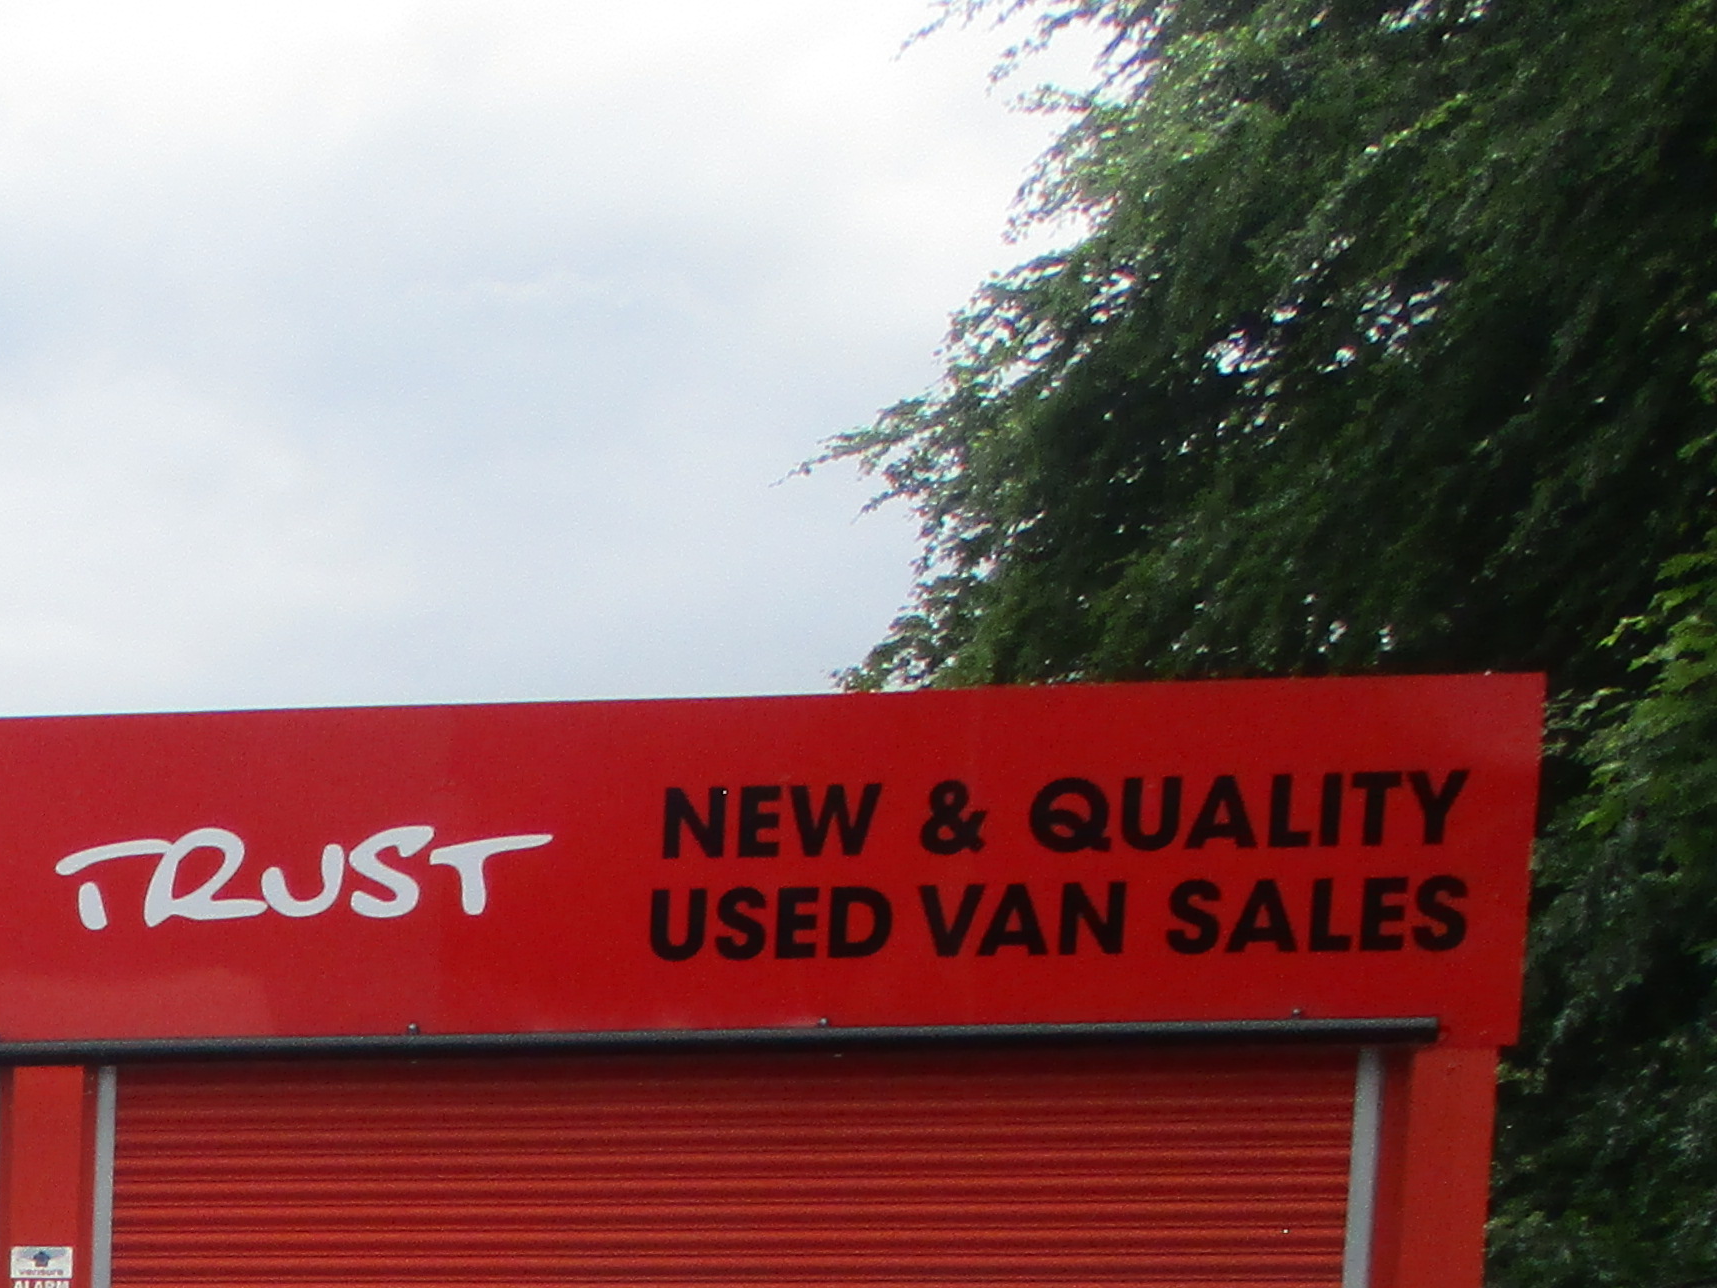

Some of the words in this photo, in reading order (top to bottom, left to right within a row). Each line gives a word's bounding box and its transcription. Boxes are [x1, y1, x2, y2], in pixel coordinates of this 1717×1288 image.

[662, 784, 882, 859] NEW
[921, 779, 987, 855] &
[1029, 769, 1470, 853] QUALITY
[54, 824, 554, 931] TRUST
[649, 885, 893, 962] USED
[920, 881, 1128, 957] VAN
[1166, 874, 1469, 955] SALES
